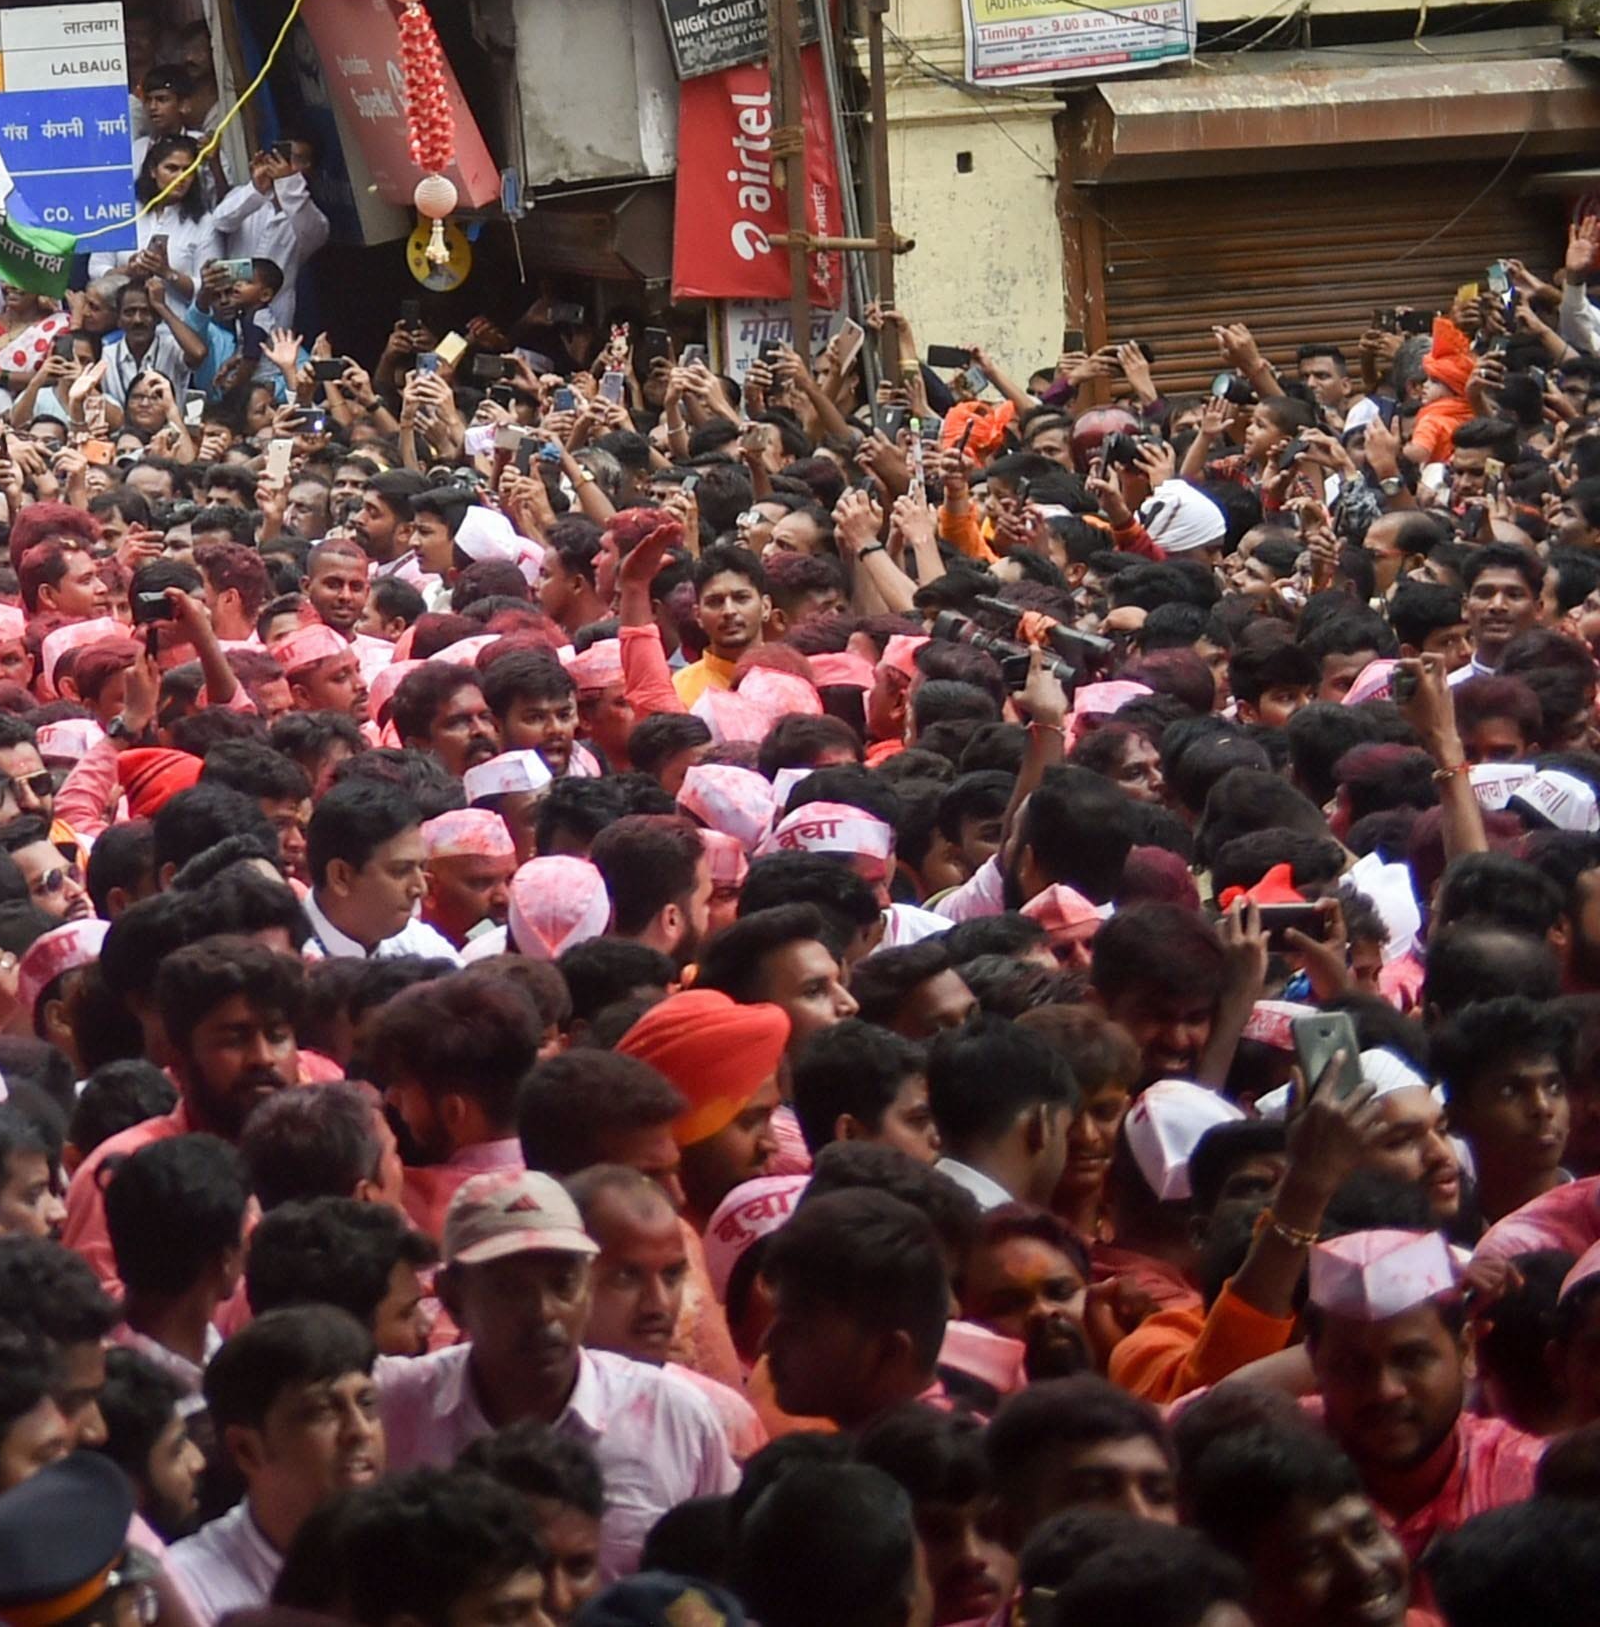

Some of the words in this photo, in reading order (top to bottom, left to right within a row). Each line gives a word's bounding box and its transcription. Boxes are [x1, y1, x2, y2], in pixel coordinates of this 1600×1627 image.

[710, 0, 754, 26] COURT
[63, 19, 119, 35] लालबाग
[979, 24, 1034, 42] Timings
[1052, 18, 1080, 33] 9.00
[51, 58, 122, 75] LALBAUG
[42, 117, 84, 140] कंपनी
[727, 92, 772, 213] airtel
[44, 207, 74, 222] CO.
[85, 203, 134, 220] LANE
[33, 247, 64, 273] पक्ष
